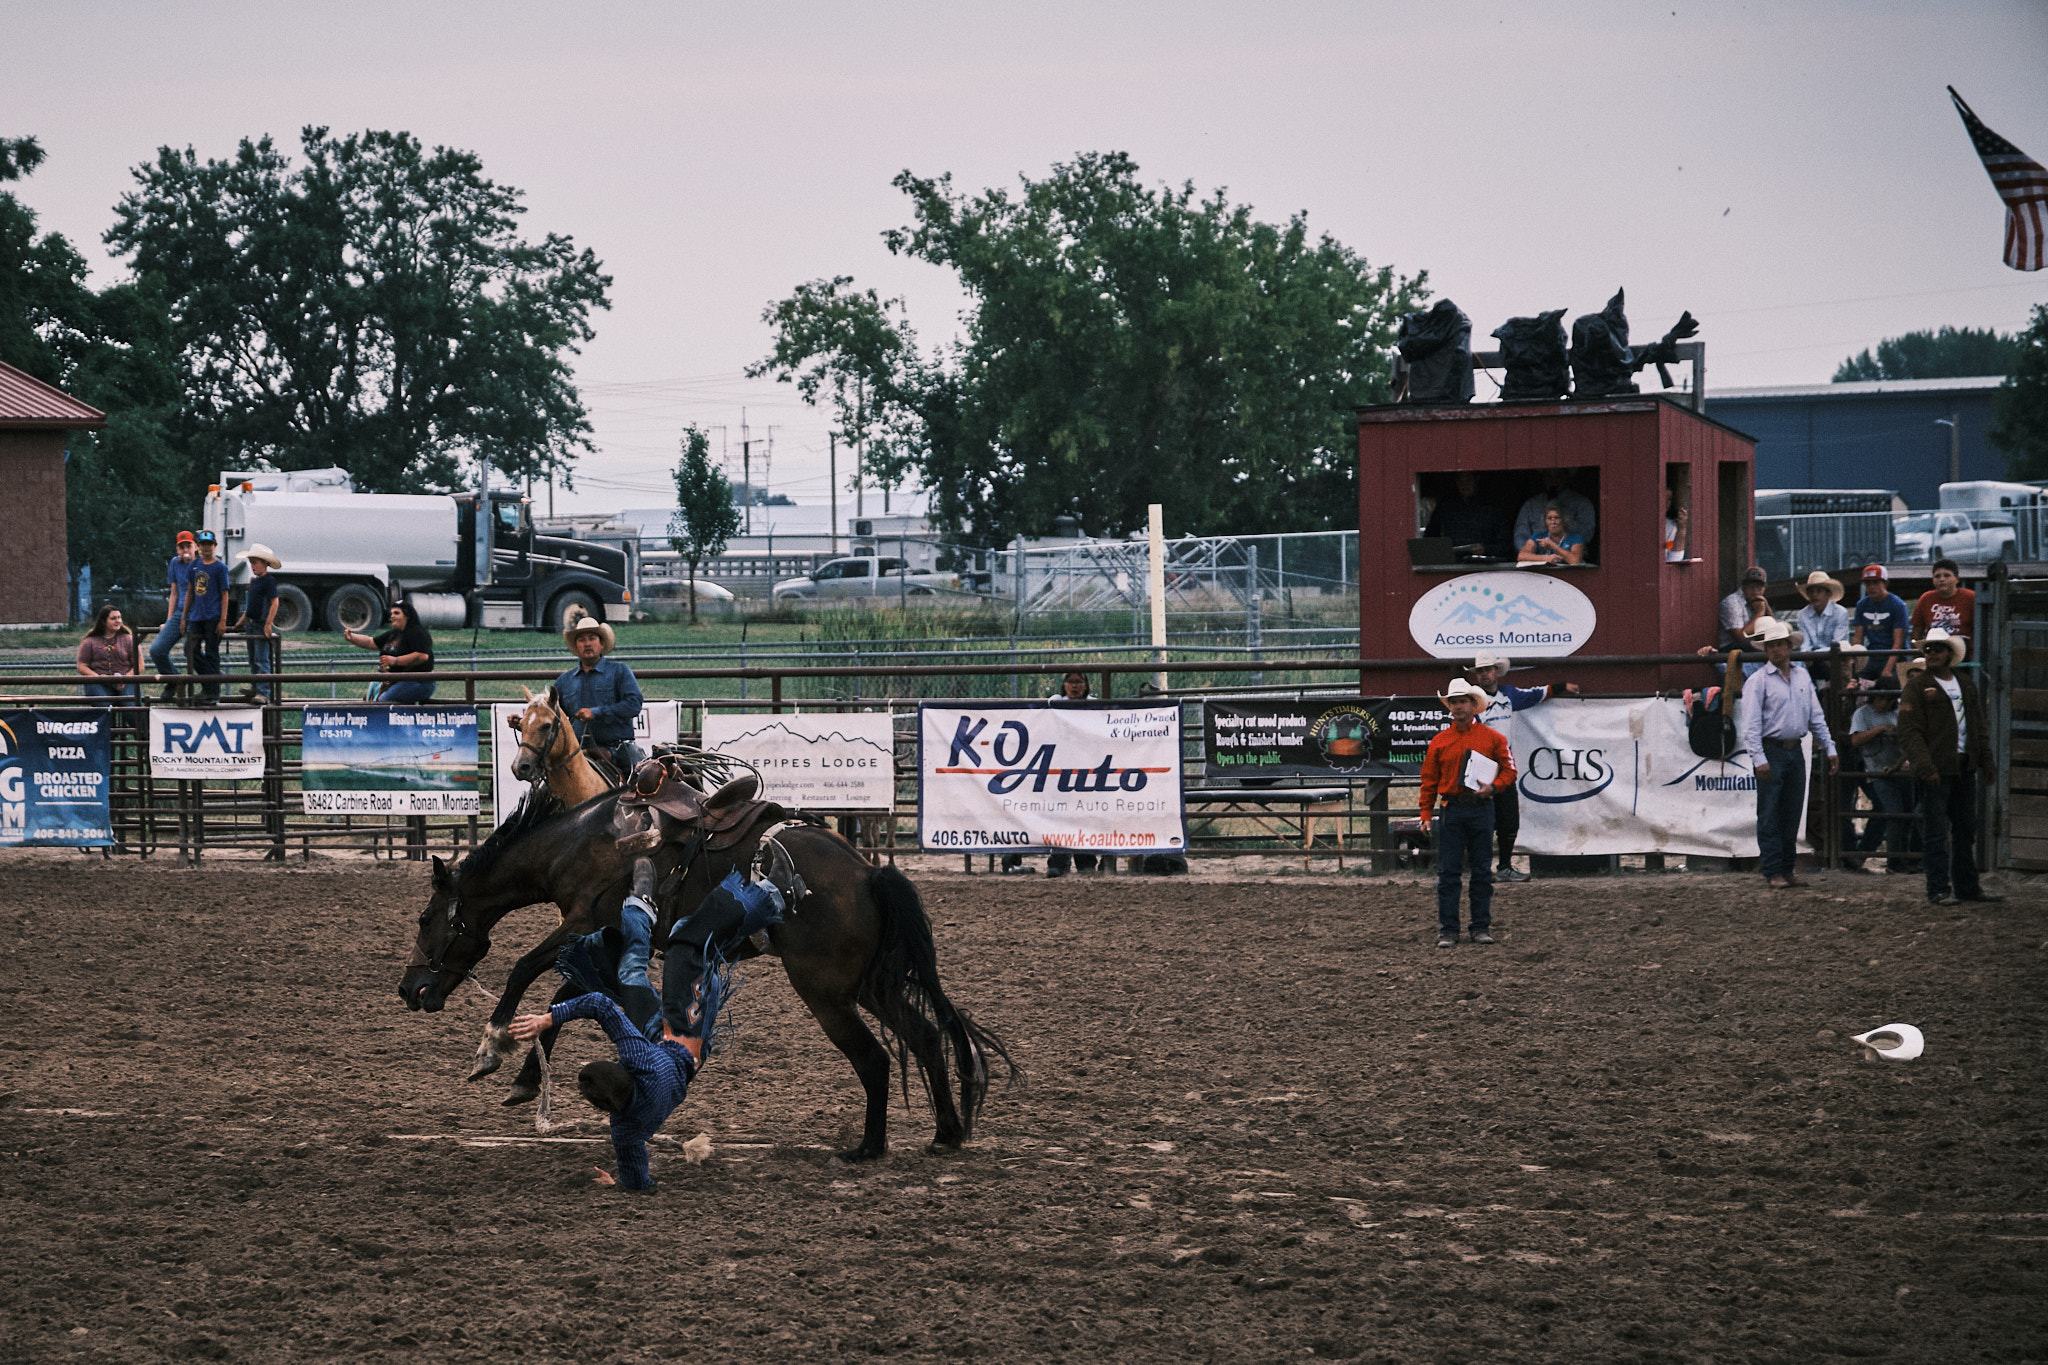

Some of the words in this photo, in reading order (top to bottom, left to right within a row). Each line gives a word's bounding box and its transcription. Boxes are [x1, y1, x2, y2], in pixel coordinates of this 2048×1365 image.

[1434, 633, 1494, 645] Access
[1500, 632, 1572, 644] Montana
[346, 712, 368, 729] Pumps
[388, 712, 415, 726] Mission
[415, 712, 436, 728] Valley
[446, 712, 477, 728] Irrigation
[1106, 713, 1140, 727] Locally
[1144, 711, 1176, 723] Owned
[1333, 705, 1371, 720] TIMBERS
[36, 721, 98, 735] BURGERS
[1215, 713, 1244, 730] Specialty
[1245, 715, 1257, 727] cut
[1257, 713, 1277, 727] wood
[1278, 713, 1307, 730] products
[1440, 722, 1451, 731] M
[163, 715, 253, 754] RMT
[319, 729, 353, 738] 675-3179
[947, 715, 1030, 768] K-O
[1110, 727, 1120, 738] &
[1123, 725, 1169, 742] Operated
[1216, 732, 1239, 748] Rough
[1240, 732, 1247, 746] &
[1248, 732, 1277, 746] finished
[1277, 732, 1304, 746] lumber
[48, 746, 86, 760] PIZZA
[152, 755, 182, 764] ROCKY
[185, 755, 229, 764] MOUNTAIN
[231, 755, 263, 764] TWIST
[1217, 751, 1235, 767] Open
[1236, 753, 1244, 765] to
[1246, 751, 1258, 764] the
[1259, 751, 1281, 767] public
[1388, 751, 1427, 763] huntsti
[821, 757, 878, 768] LODGE
[987, 744, 1148, 794] Auto
[1528, 747, 1604, 782] CHS
[33, 772, 103, 785] BROASTED
[764, 780, 815, 791] pipeslodge.com
[1695, 774, 1758, 791] Mountain
[40, 785, 97, 798] CHICKEN
[802, 793, 837, 801] Restaurant
[846, 793, 871, 802] Lounge
[307, 793, 333, 810] 36482
[335, 793, 368, 810] Carbine
[370, 793, 393, 810] Road
[410, 793, 441, 811] Ronan,
[442, 793, 480, 811] Montana
[1003, 799, 1068, 812] Premium
[1075, 799, 1109, 812] Auto
[1116, 799, 1166, 813] Repair
[0, 802, 26, 828] M
[931, 830, 1030, 846] 406.676.AUTO
[1042, 830, 1156, 847] www.k-oauto.com
